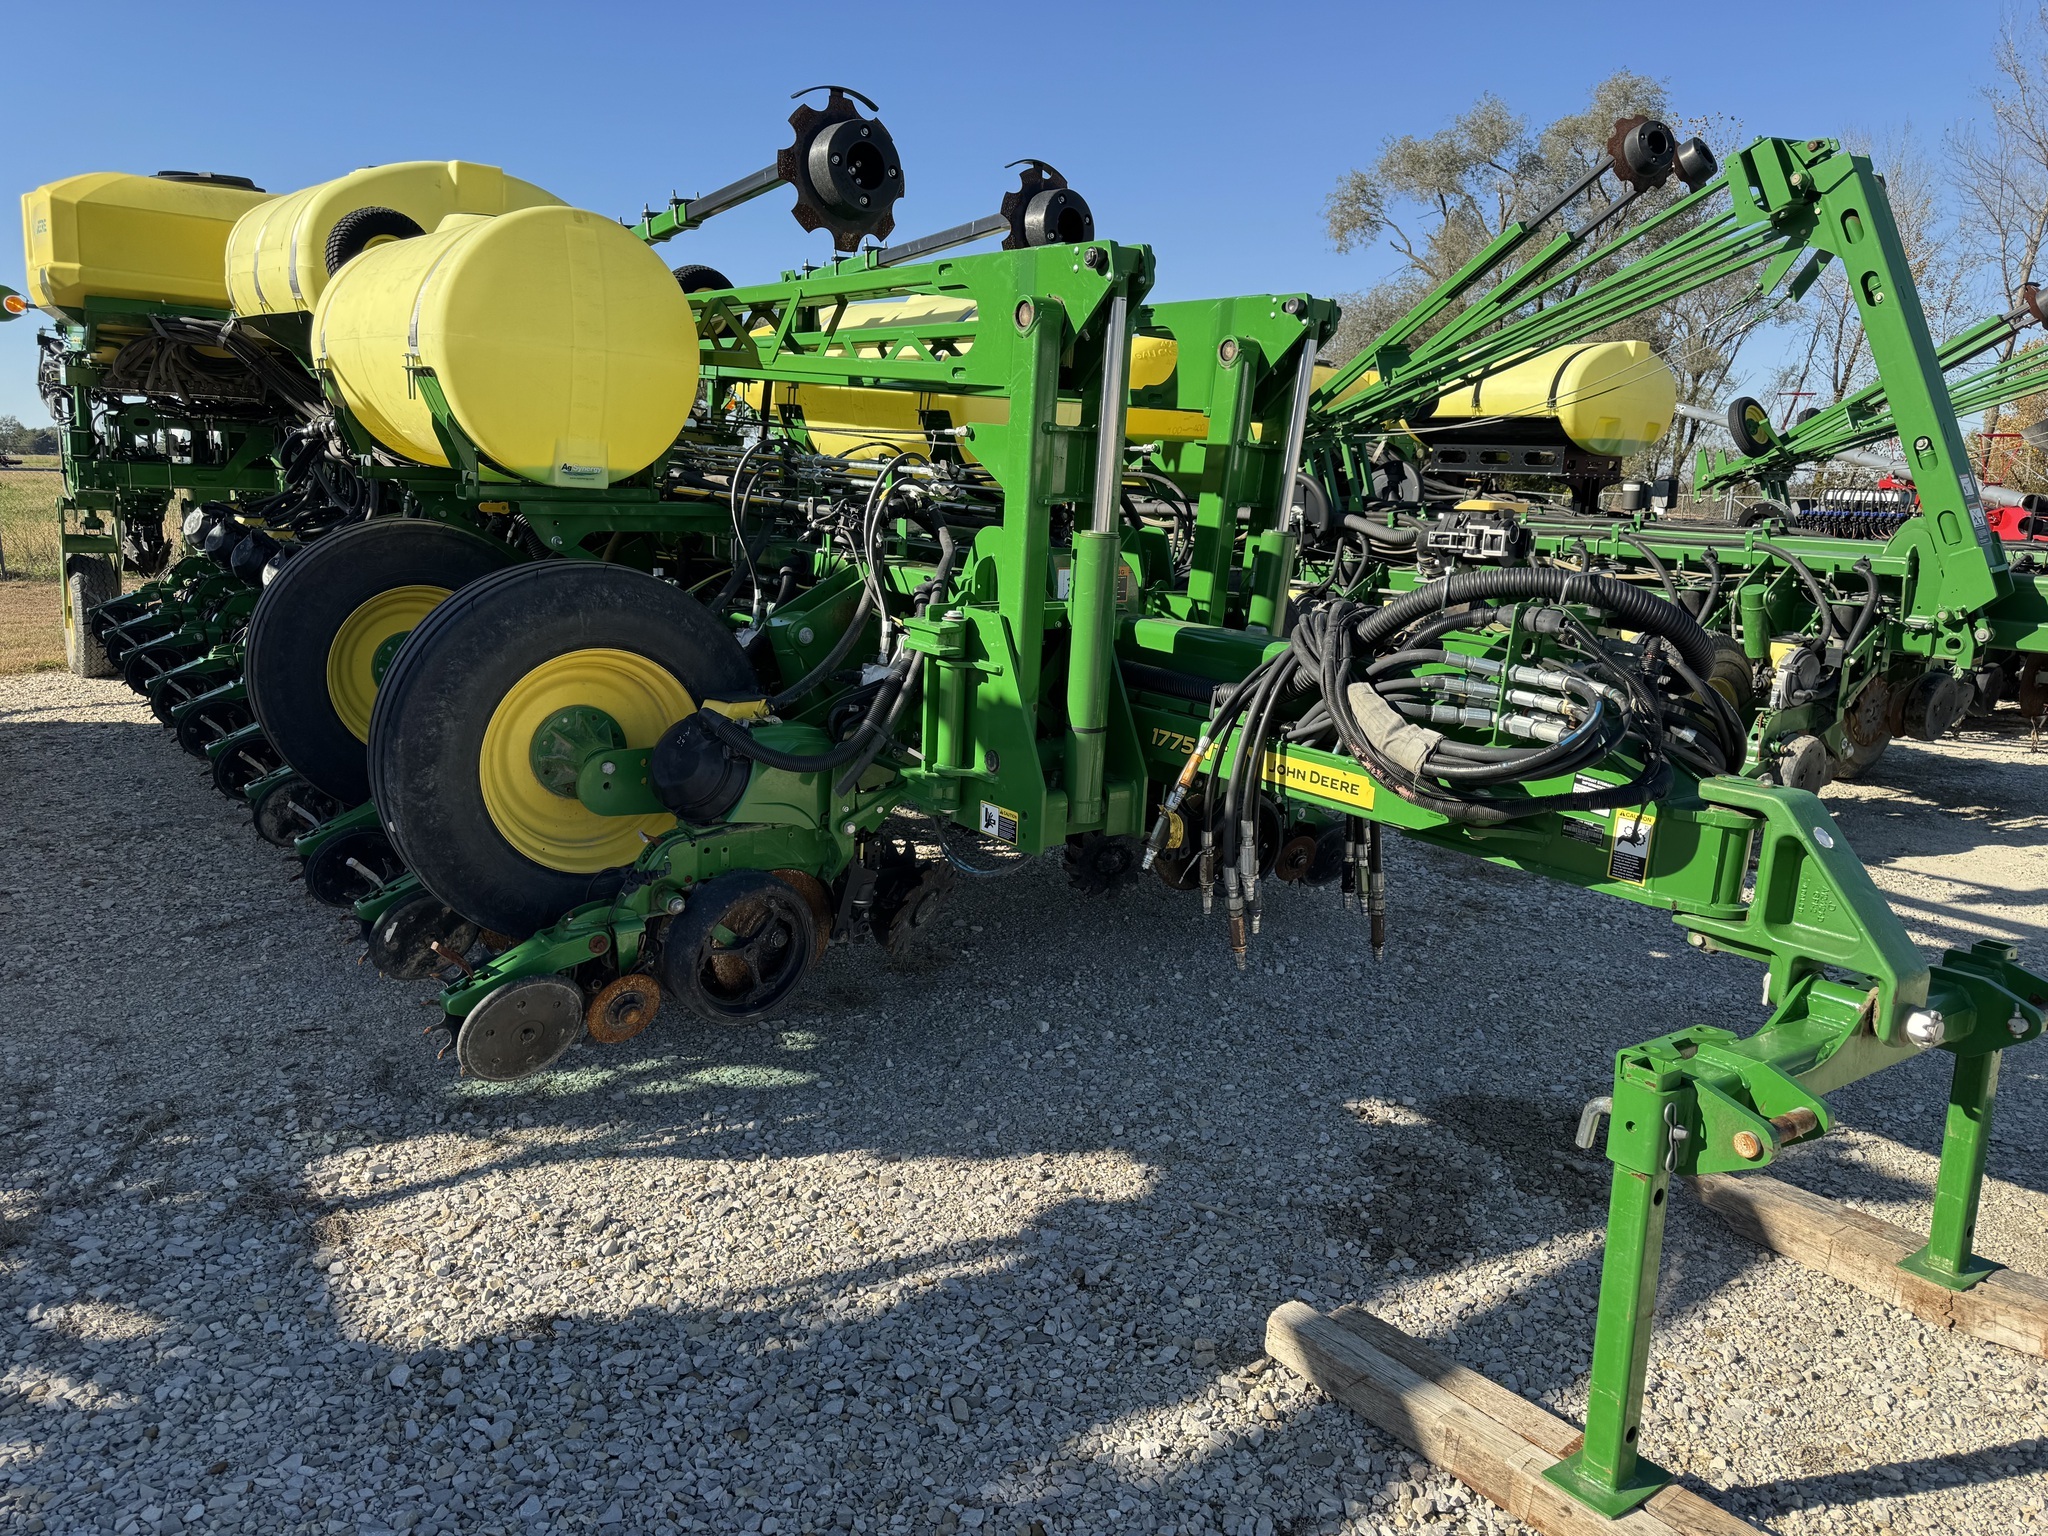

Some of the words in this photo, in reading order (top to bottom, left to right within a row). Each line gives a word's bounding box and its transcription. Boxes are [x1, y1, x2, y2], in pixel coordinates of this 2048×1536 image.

[561, 463, 601, 473] AgSynergy
[1268, 760, 1306, 782] JOHN
[1309, 770, 1360, 796] DEERE
